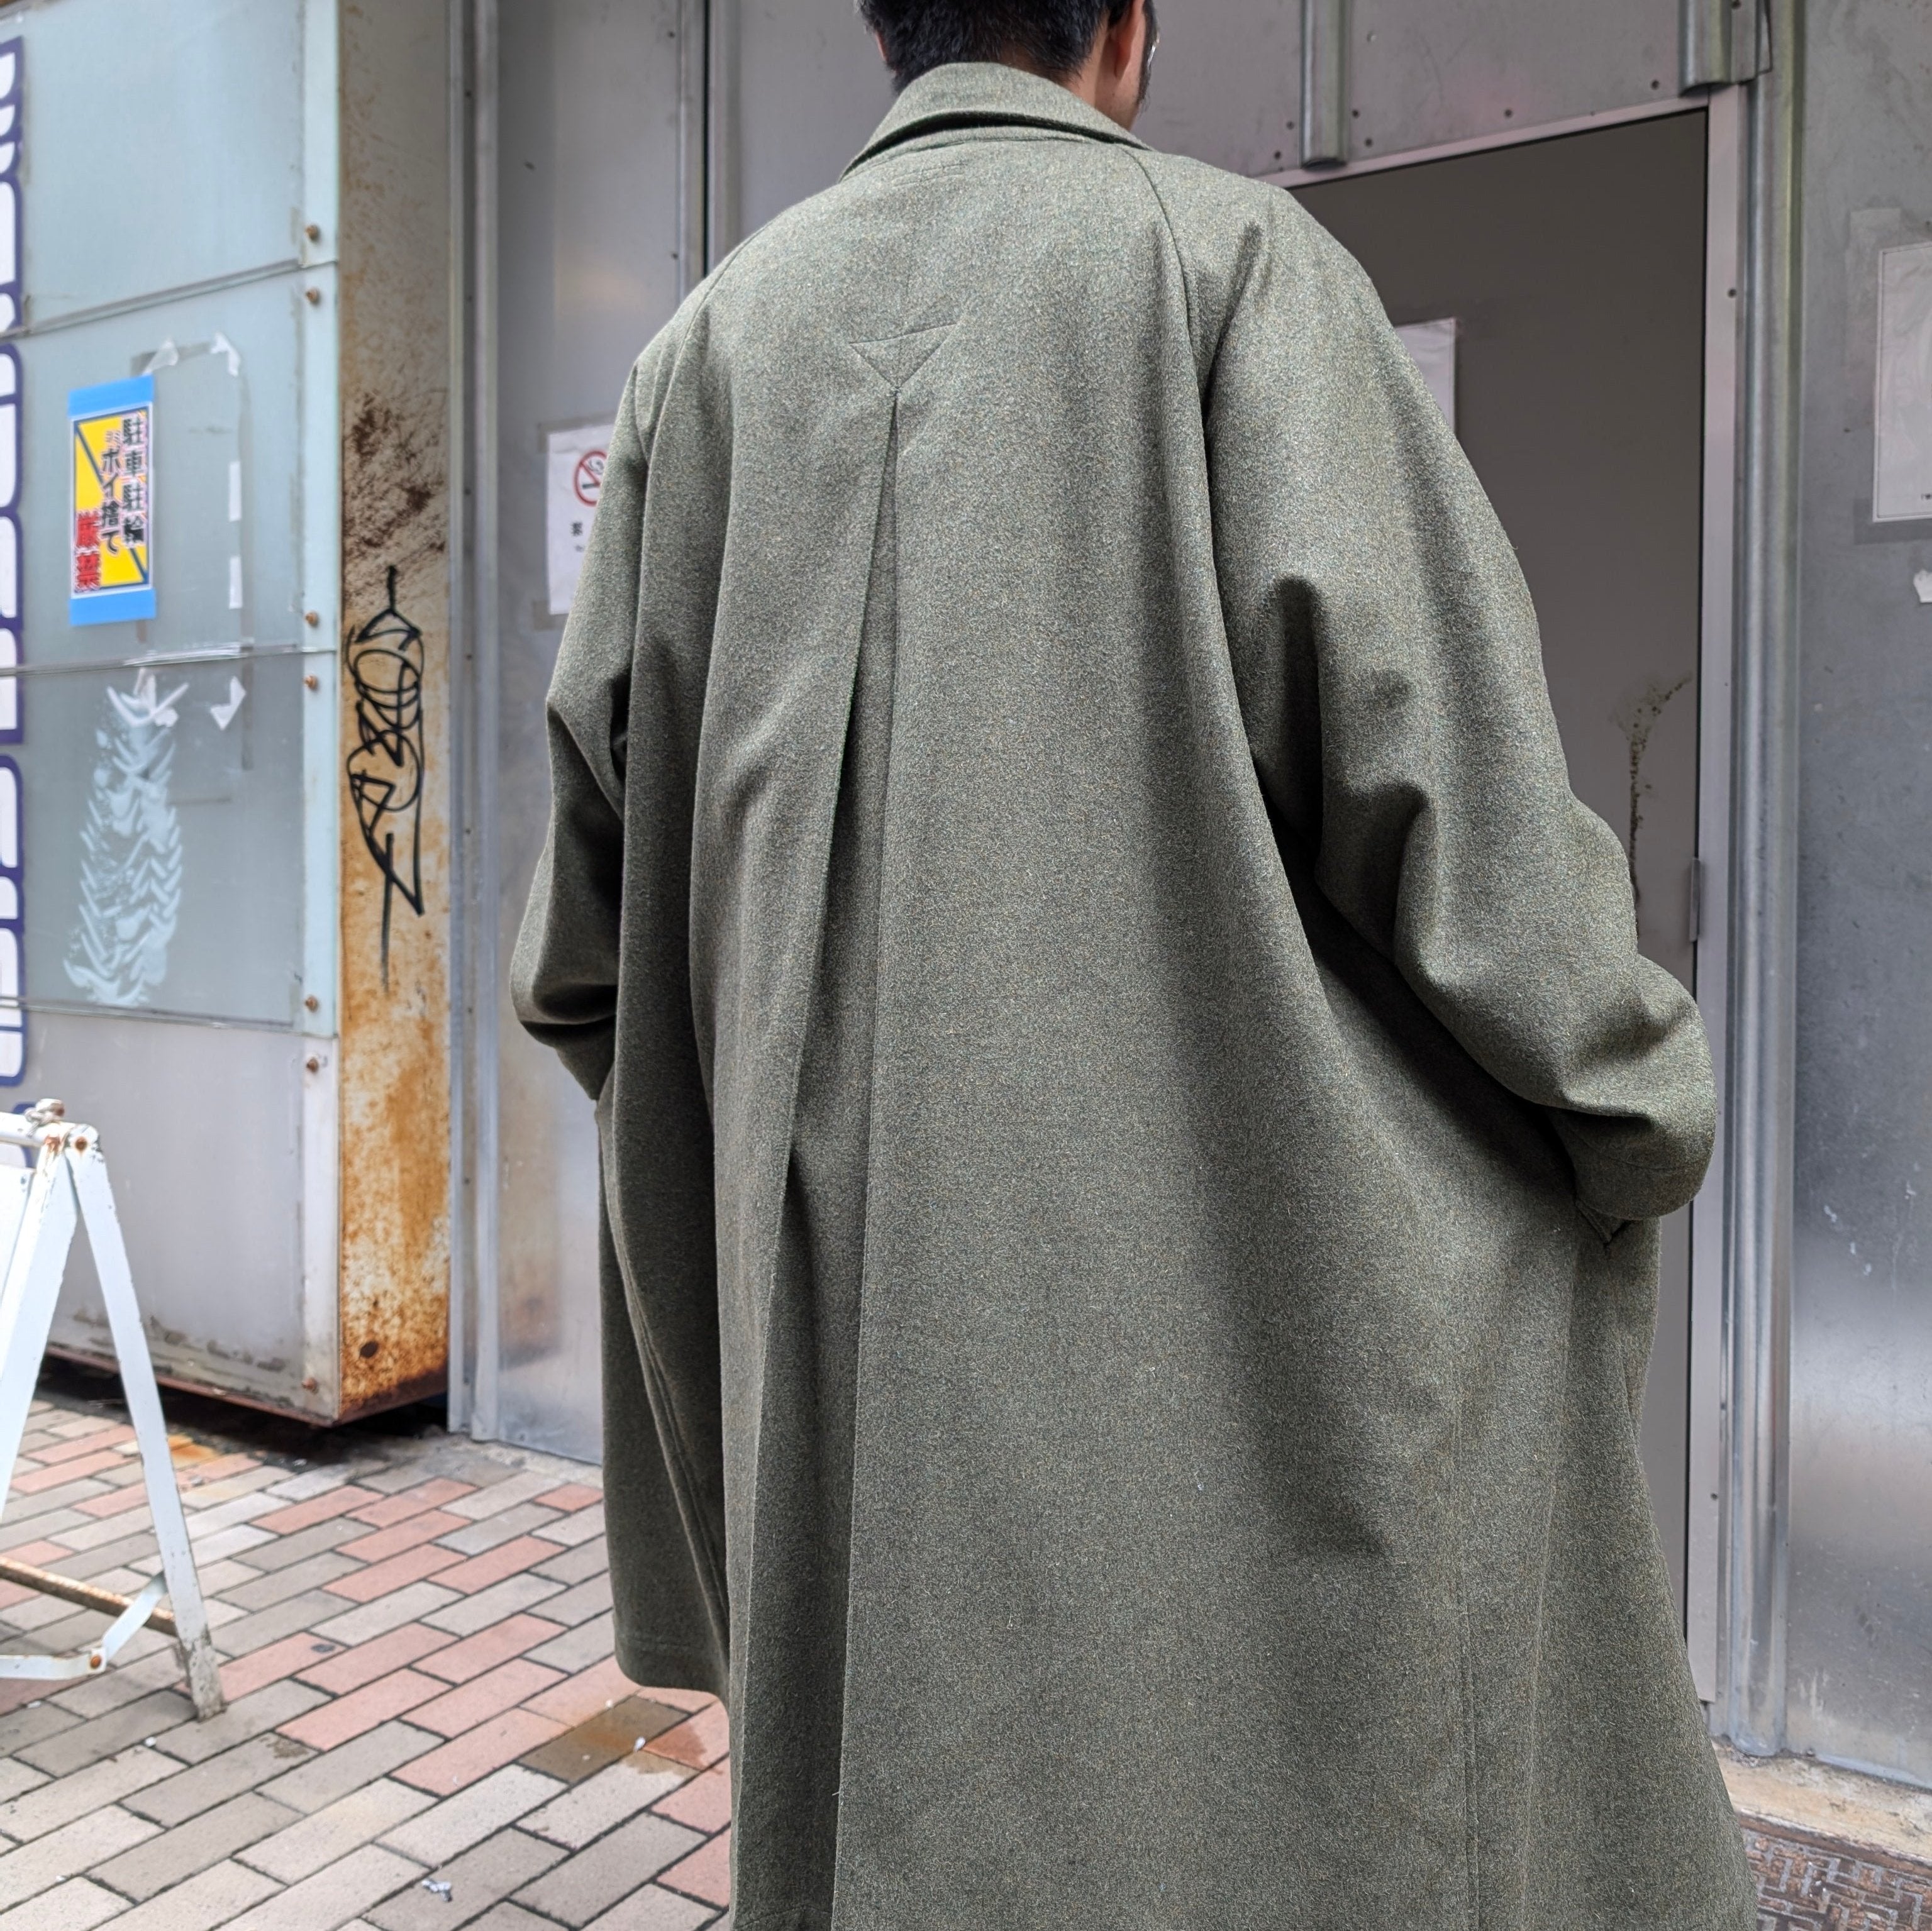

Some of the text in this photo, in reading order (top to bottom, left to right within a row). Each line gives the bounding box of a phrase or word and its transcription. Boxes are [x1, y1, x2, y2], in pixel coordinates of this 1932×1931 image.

[102, 445, 121, 553] ポイ捨て
[123, 418, 144, 543] 駐車駐輪
[75, 511, 100, 587] 厳禁
